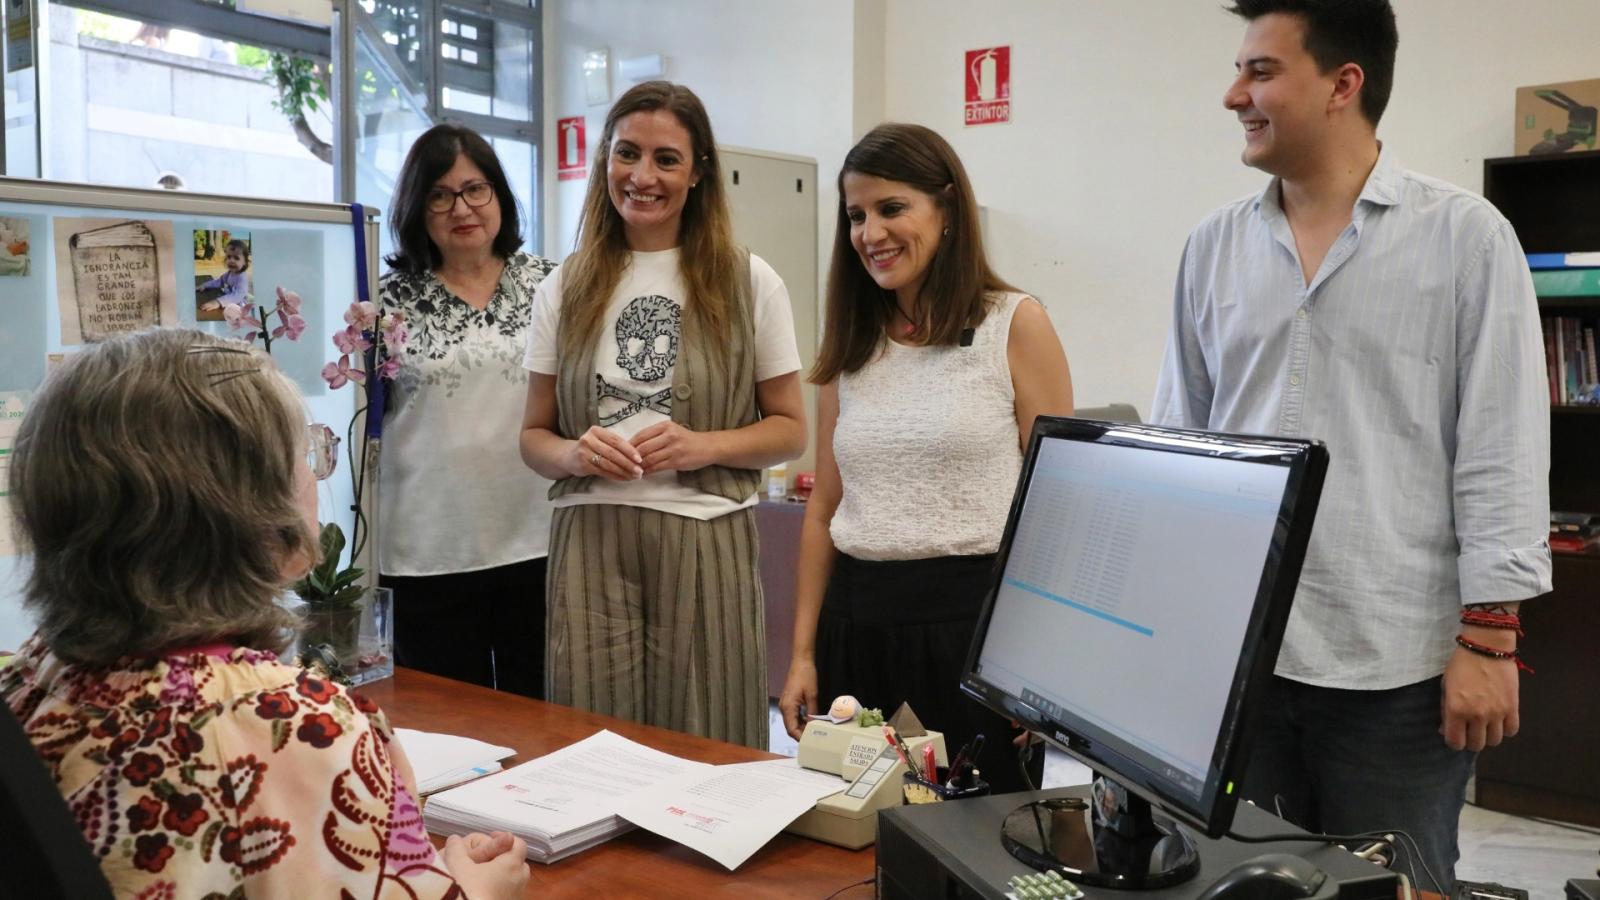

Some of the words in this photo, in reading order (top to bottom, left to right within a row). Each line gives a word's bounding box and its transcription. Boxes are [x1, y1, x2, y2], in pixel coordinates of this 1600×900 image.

[966, 105, 1009, 121] EXTINTOR
[109, 252, 121, 262] LA
[83, 261, 150, 274] IGNORANCIA
[97, 274, 109, 282] ES
[97, 280, 136, 291] GRANDE
[99, 292, 117, 301] QUE
[95, 301, 143, 312] LADRONES
[89, 313, 103, 323] NO
[108, 311, 143, 321] ROBAN
